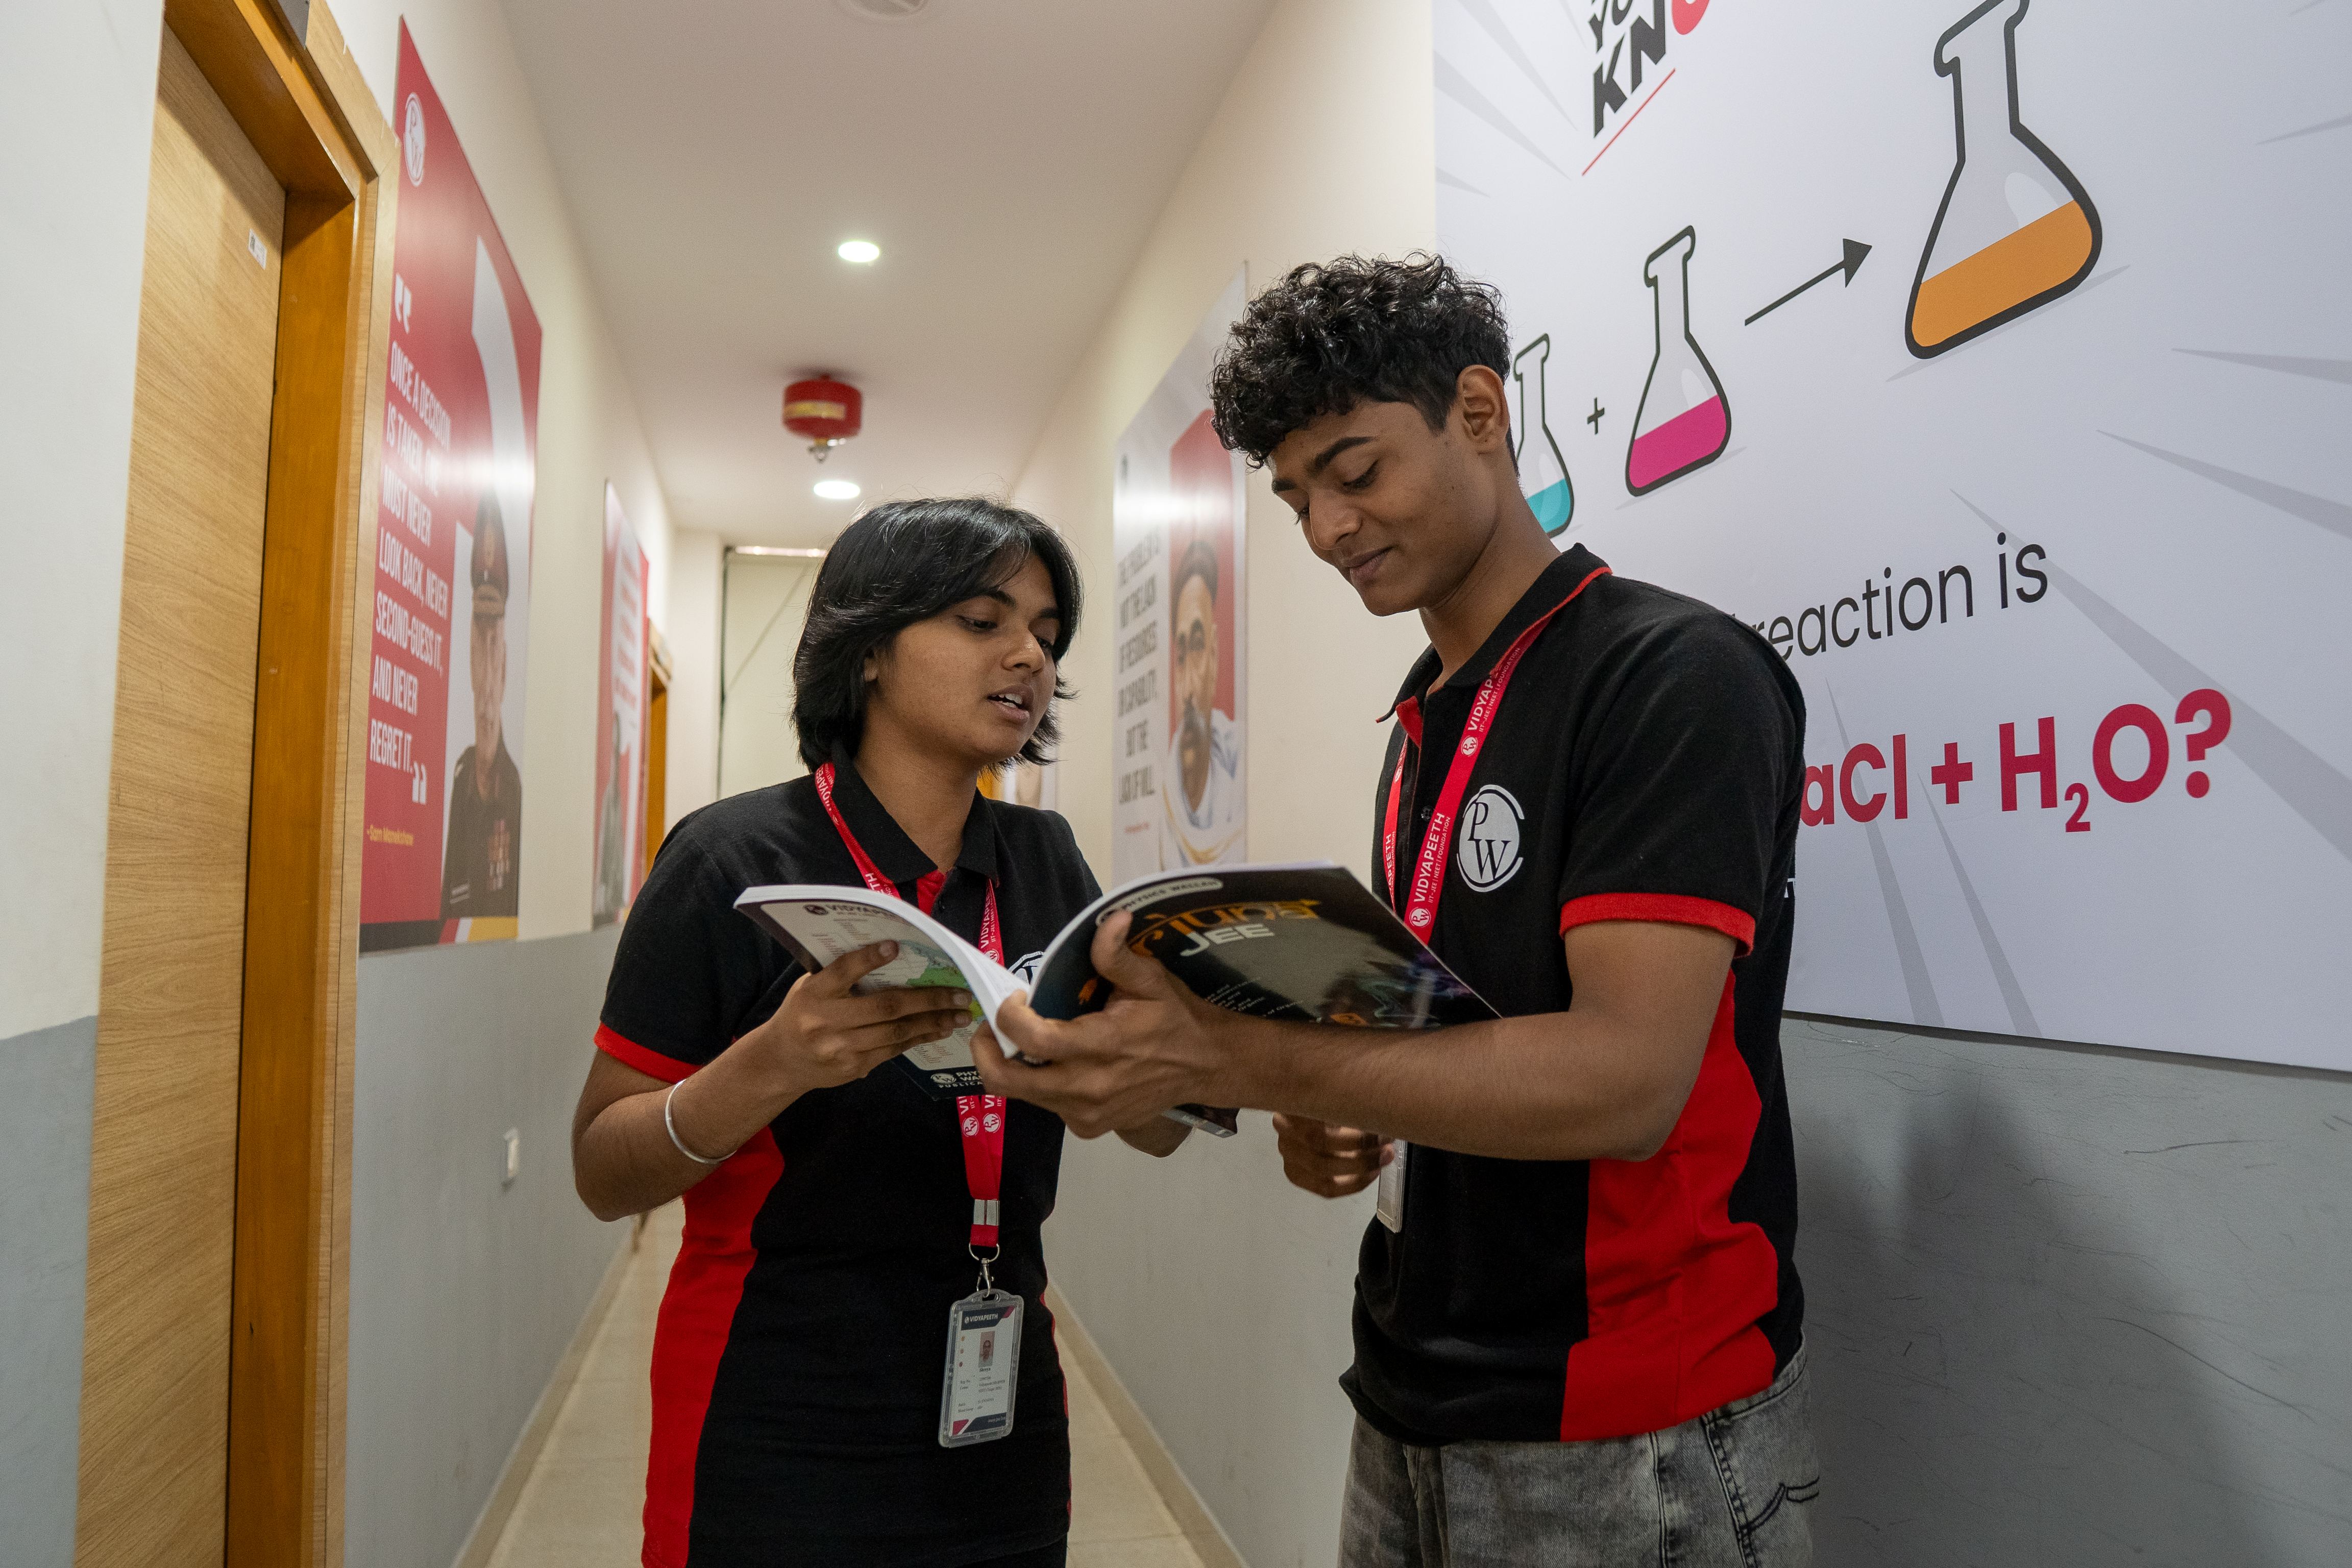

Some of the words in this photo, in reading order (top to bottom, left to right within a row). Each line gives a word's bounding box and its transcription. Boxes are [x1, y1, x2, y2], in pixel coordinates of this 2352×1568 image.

[390, 341, 414, 404] ONCE
[412, 371, 420, 413] A
[386, 402, 397, 448] IS
[382, 464, 407, 523] MUST
[407, 489, 432, 548] NEVER
[379, 526, 403, 583] LOOK
[402, 547, 424, 607] BACK,
[425, 568, 449, 621] NEVER
[1997, 532, 2048, 609] is
[376, 590, 434, 667] SECOND-GUESS
[433, 632, 444, 679] IT,
[372, 653, 391, 704] AND
[392, 665, 419, 717] NEVER
[1468, 673, 1498, 731] VIDYAP
[1479, 709, 1491, 732] IIT-JEE
[1489, 691, 1499, 706] NEET
[1497, 647, 1521, 688] FOUNDATION
[370, 718, 403, 771] REGRET
[403, 732, 413, 775] IT.
[1413, 812, 1446, 902] VIDYAPEETH
[1428, 882, 1437, 903] IIT-JEE
[1433, 863, 1441, 879] NEET
[1437, 817, 1451, 859] FOUNDATION
[1467, 801, 1512, 880] PW
[1180, 923, 1275, 957] JEE
[970, 1313, 998, 1322] VIDYAPEETH
